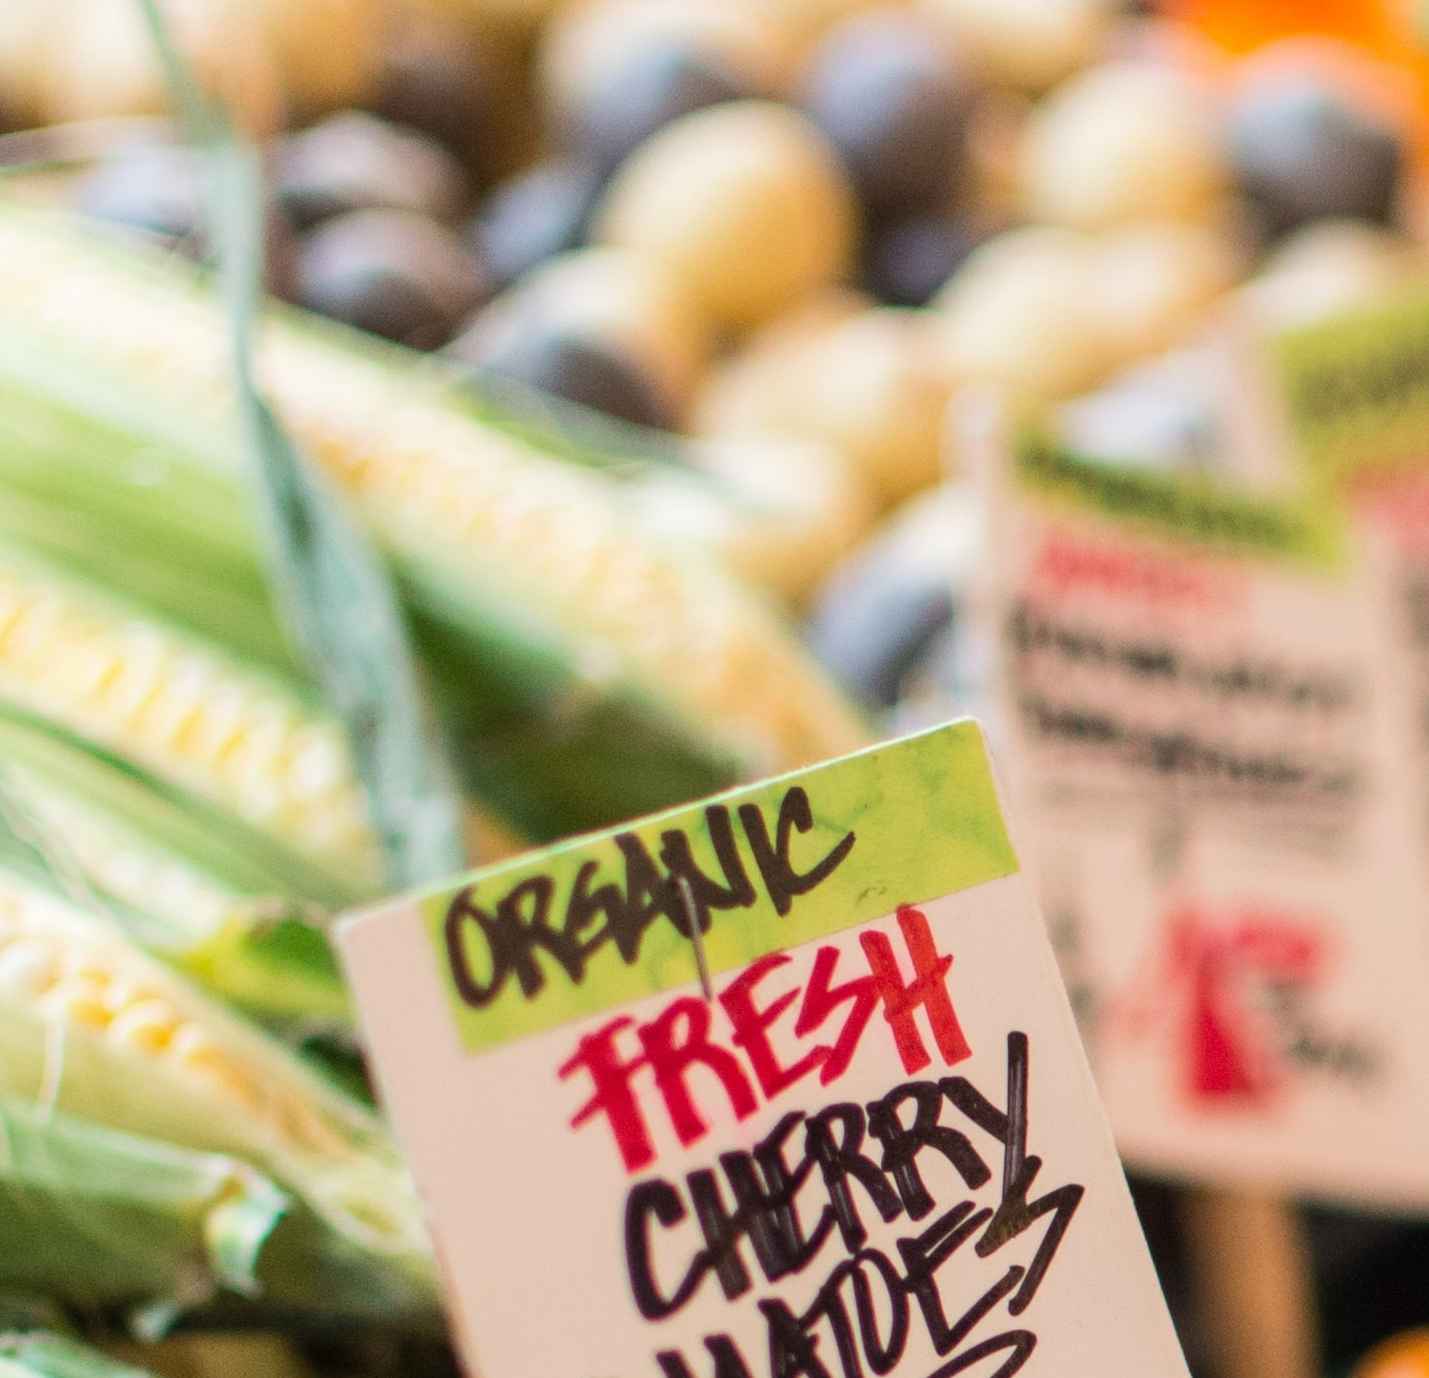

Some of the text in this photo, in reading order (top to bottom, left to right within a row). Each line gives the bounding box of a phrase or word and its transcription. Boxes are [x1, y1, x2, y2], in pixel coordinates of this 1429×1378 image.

[443, 785, 855, 1010] ORGANIC
[557, 904, 970, 1174] FRESH
[622, 1031, 1029, 1321] CHERRY
